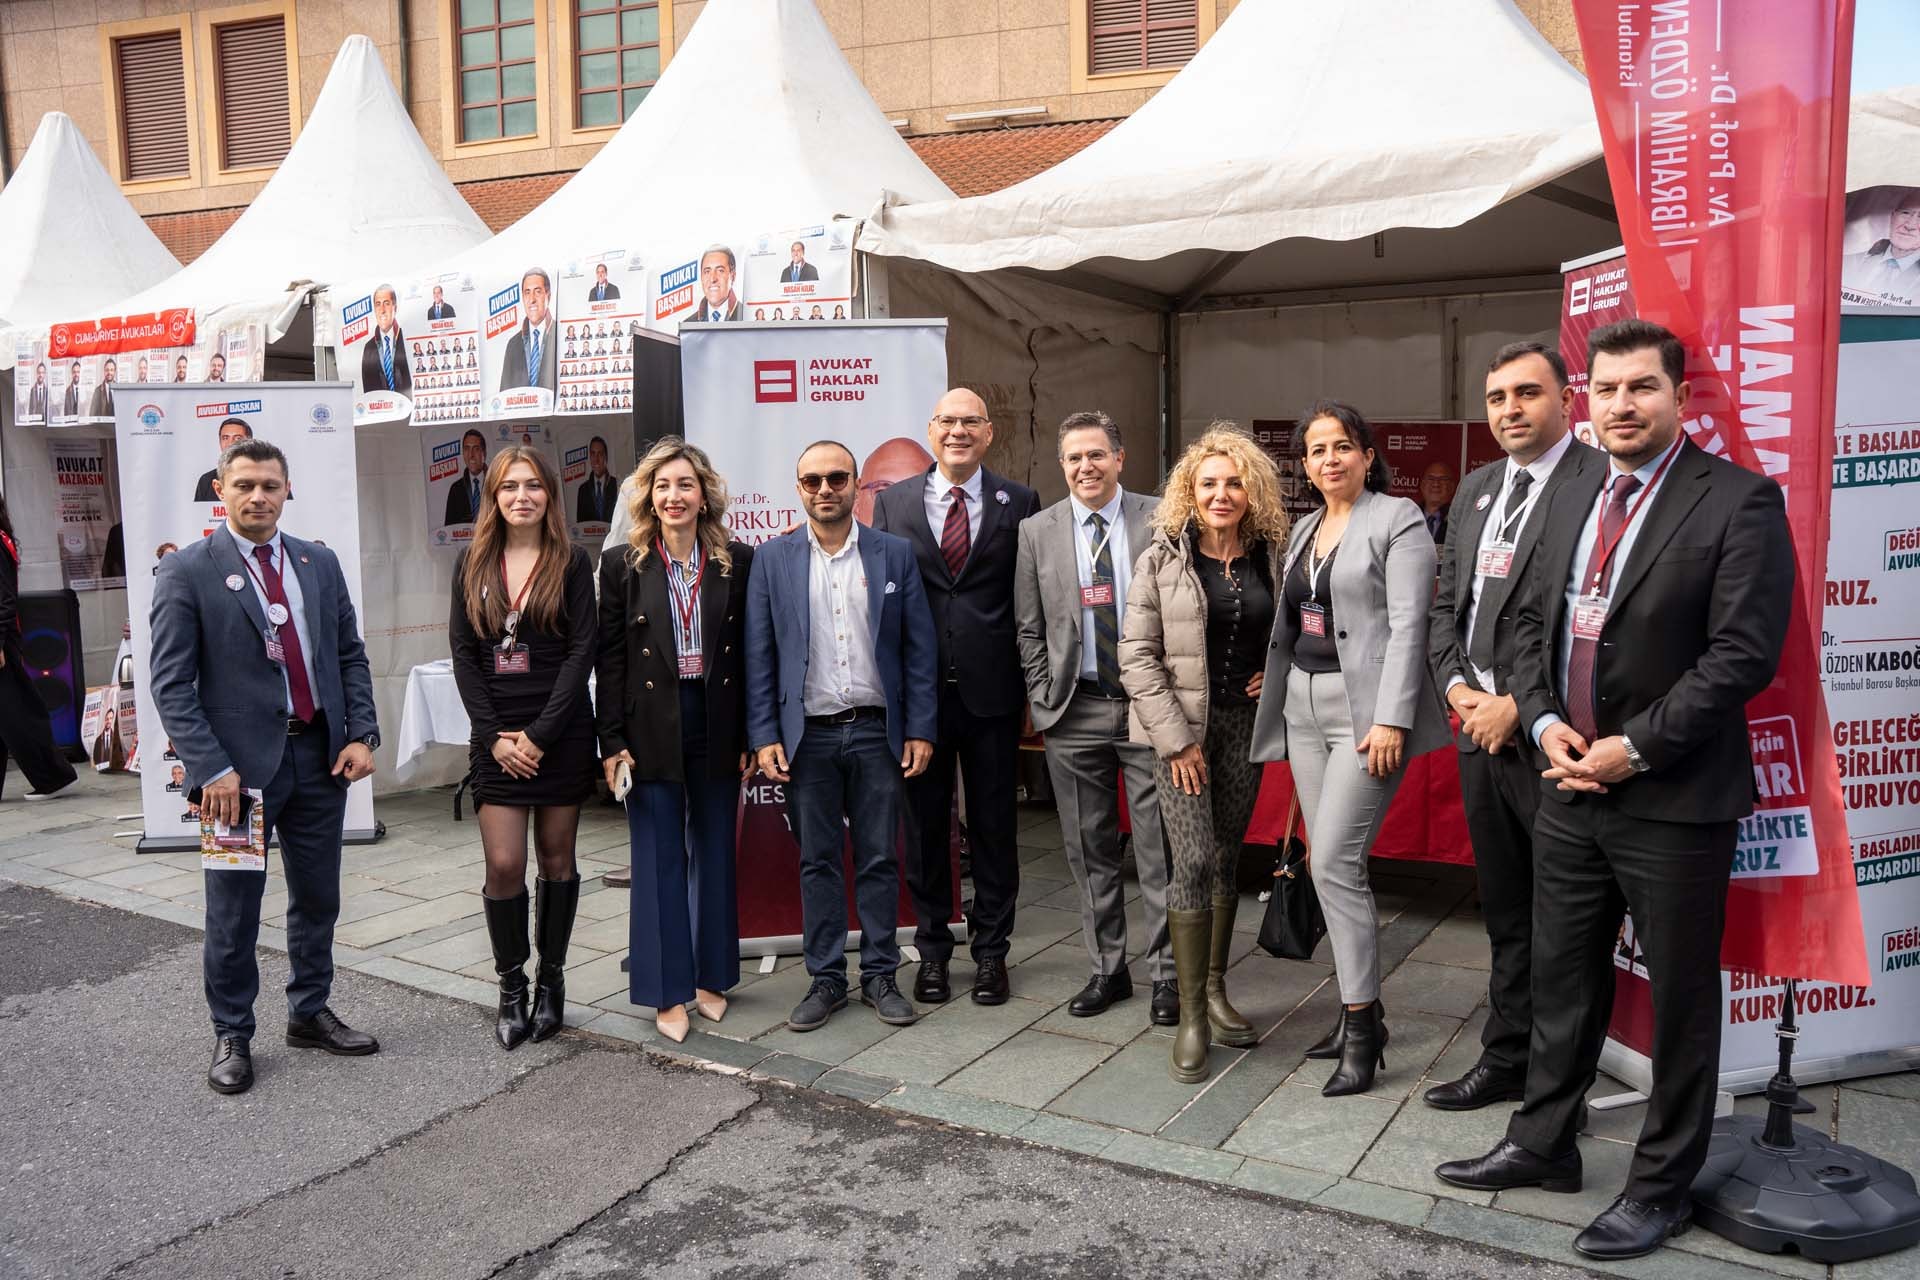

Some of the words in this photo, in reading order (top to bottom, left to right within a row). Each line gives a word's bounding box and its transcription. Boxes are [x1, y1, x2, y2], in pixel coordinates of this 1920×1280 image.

[662, 263, 697, 292] AVUKAT
[1595, 268, 1627, 285] AVUKAT
[1594, 281, 1628, 298] HAKLARI
[490, 286, 519, 313] AVUKAT
[658, 288, 692, 316] BAŞKAN
[1593, 296, 1620, 311] GRUBU
[345, 298, 371, 321] AVUKAT
[343, 320, 368, 340] BAŞKAN
[487, 310, 516, 335] BAŞKAN
[120, 323, 165, 341] AVUKATLARI
[809, 358, 873, 371] AVUKAT
[810, 373, 879, 387] HAKLARI
[810, 389, 865, 402] GRUBU
[197, 404, 228, 417] AVUKAT
[229, 401, 261, 414] BAŞKAN
[434, 441, 459, 461] AVUKAT
[56, 456, 104, 473] AVUKAT
[430, 460, 458, 478] BAŞKAN
[58, 473, 105, 486] KAZANSIN
[753, 493, 770, 504] Dr.
[1822, 631, 1838, 647] Dr.
[1826, 652, 1863, 674] ÖZDEN
[1831, 676, 1864, 692] İstanbul
[1866, 677, 1893, 690] Barosu
[1834, 713, 1920, 747] GELECEĞ
[1752, 731, 1785, 756] için
